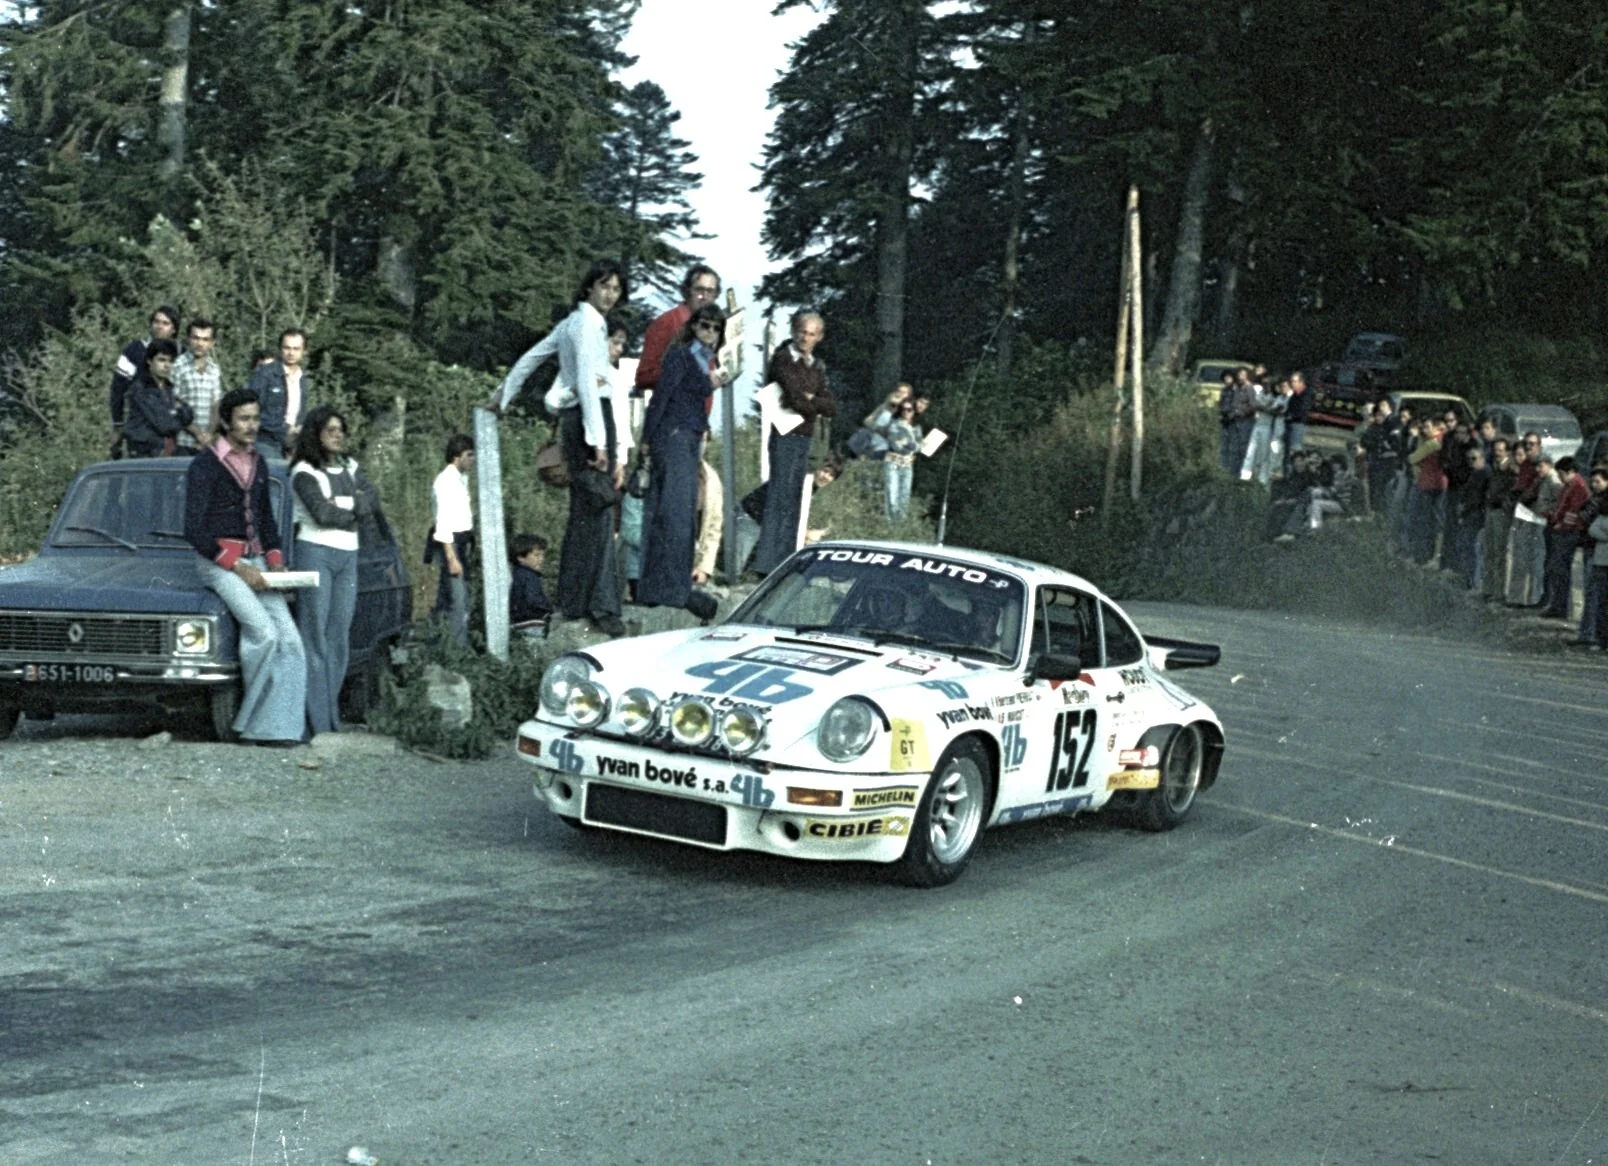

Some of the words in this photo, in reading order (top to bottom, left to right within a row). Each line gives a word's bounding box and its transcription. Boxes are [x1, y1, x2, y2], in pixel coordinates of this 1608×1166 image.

[816, 549, 895, 566] TOUR
[900, 558, 988, 584] AUTO
[936, 708, 970, 730] yvan
[900, 740, 915, 755] GT
[1045, 708, 1098, 793] 152
[596, 755, 640, 779] yvan
[644, 760, 698, 789] bové
[702, 778, 730, 794] s.a.
[854, 790, 916, 806] MICHELIN
